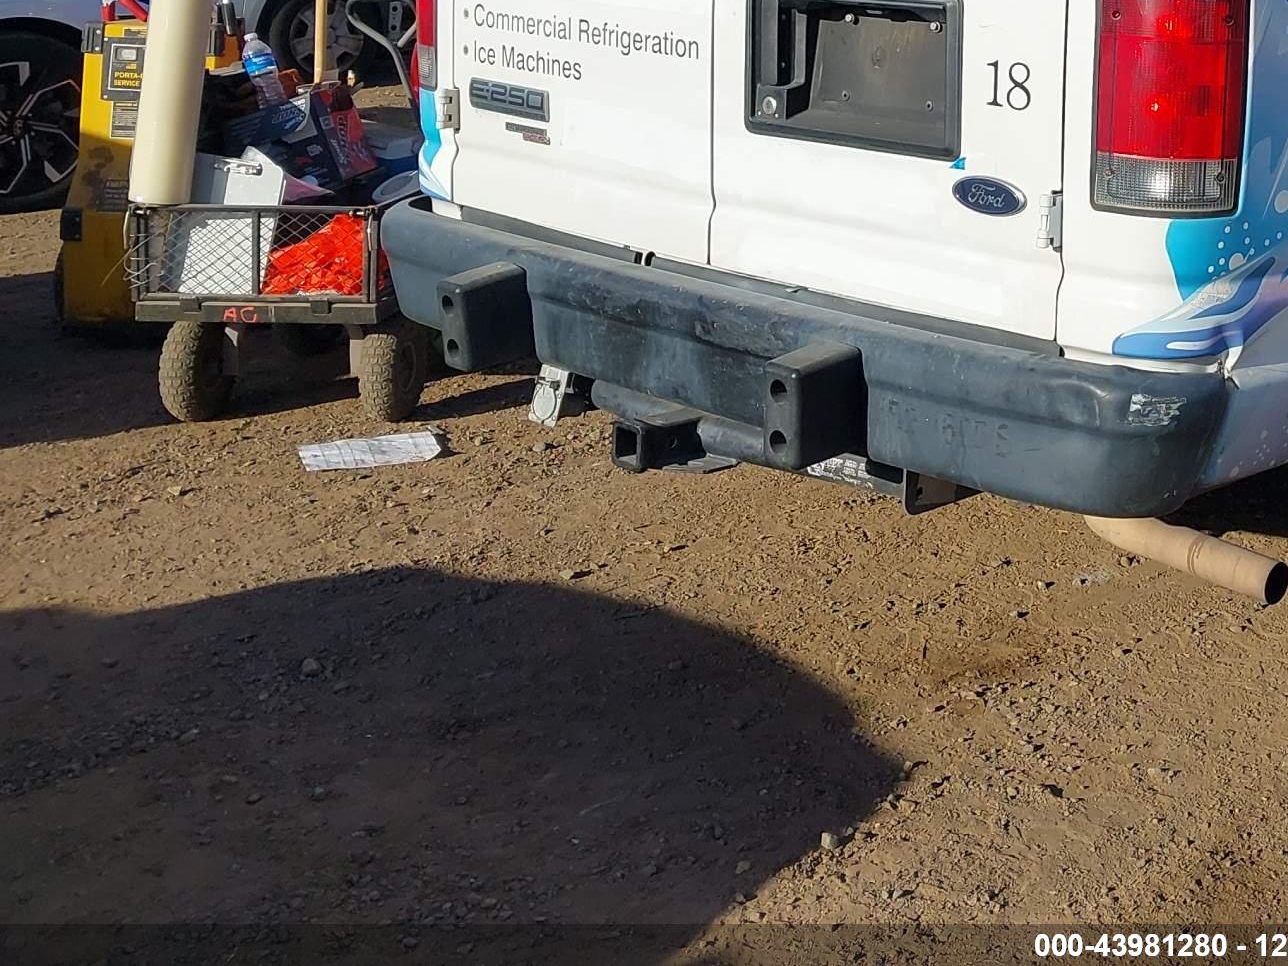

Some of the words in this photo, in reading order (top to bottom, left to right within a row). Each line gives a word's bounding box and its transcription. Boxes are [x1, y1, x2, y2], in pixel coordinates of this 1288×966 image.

[474, 2, 572, 41] Commercial
[578, 18, 700, 60] Refrigeration
[473, 39, 497, 66] Ice
[501, 44, 583, 81] Machines
[986, 59, 1032, 111] 18
[967, 183, 1006, 208] Ford
